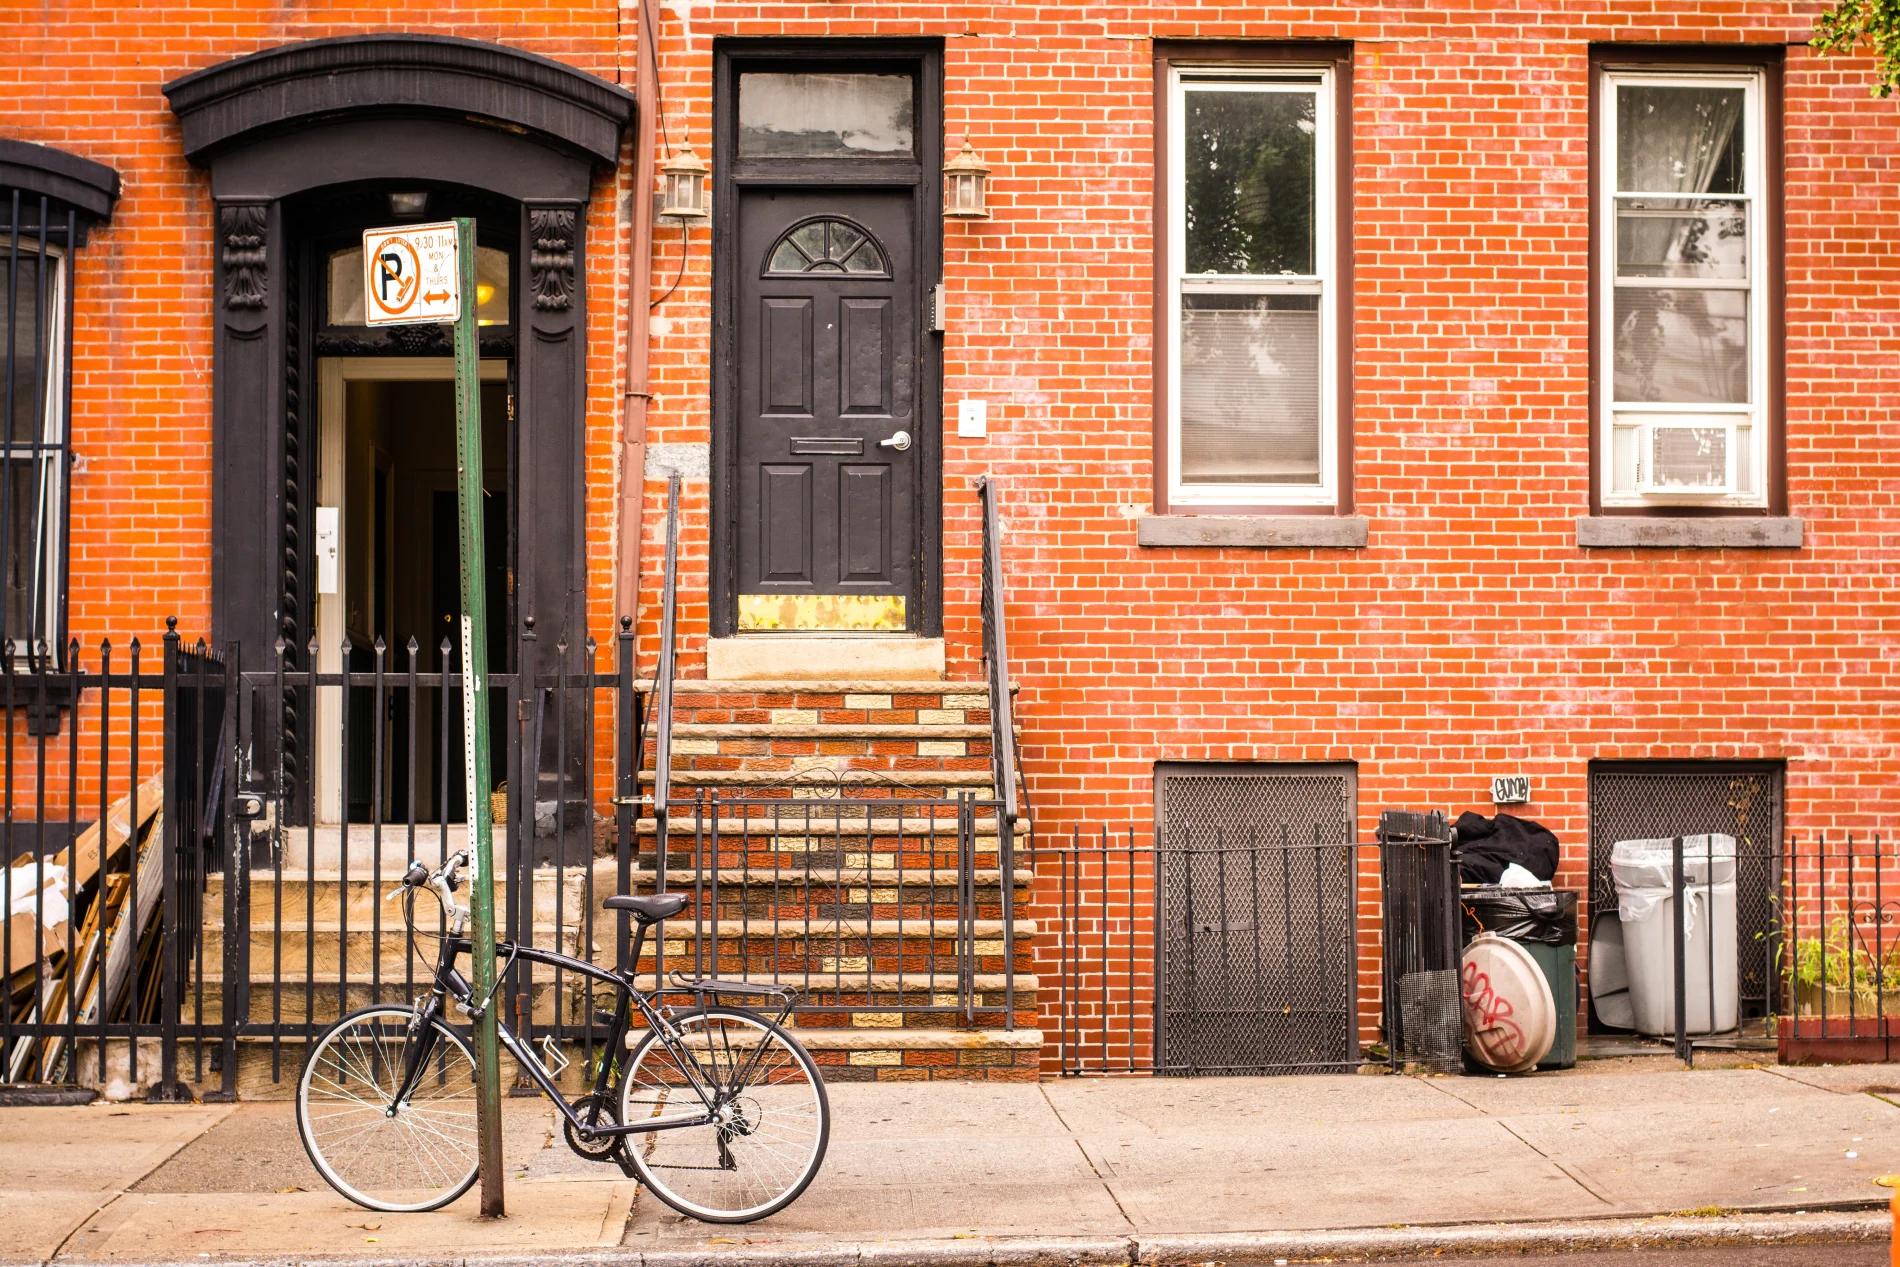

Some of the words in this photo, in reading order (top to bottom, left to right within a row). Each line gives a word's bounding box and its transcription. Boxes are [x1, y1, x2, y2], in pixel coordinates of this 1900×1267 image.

[428, 251, 444, 260] MON
[433, 263, 439, 272] &
[426, 275, 448, 286] THURS
